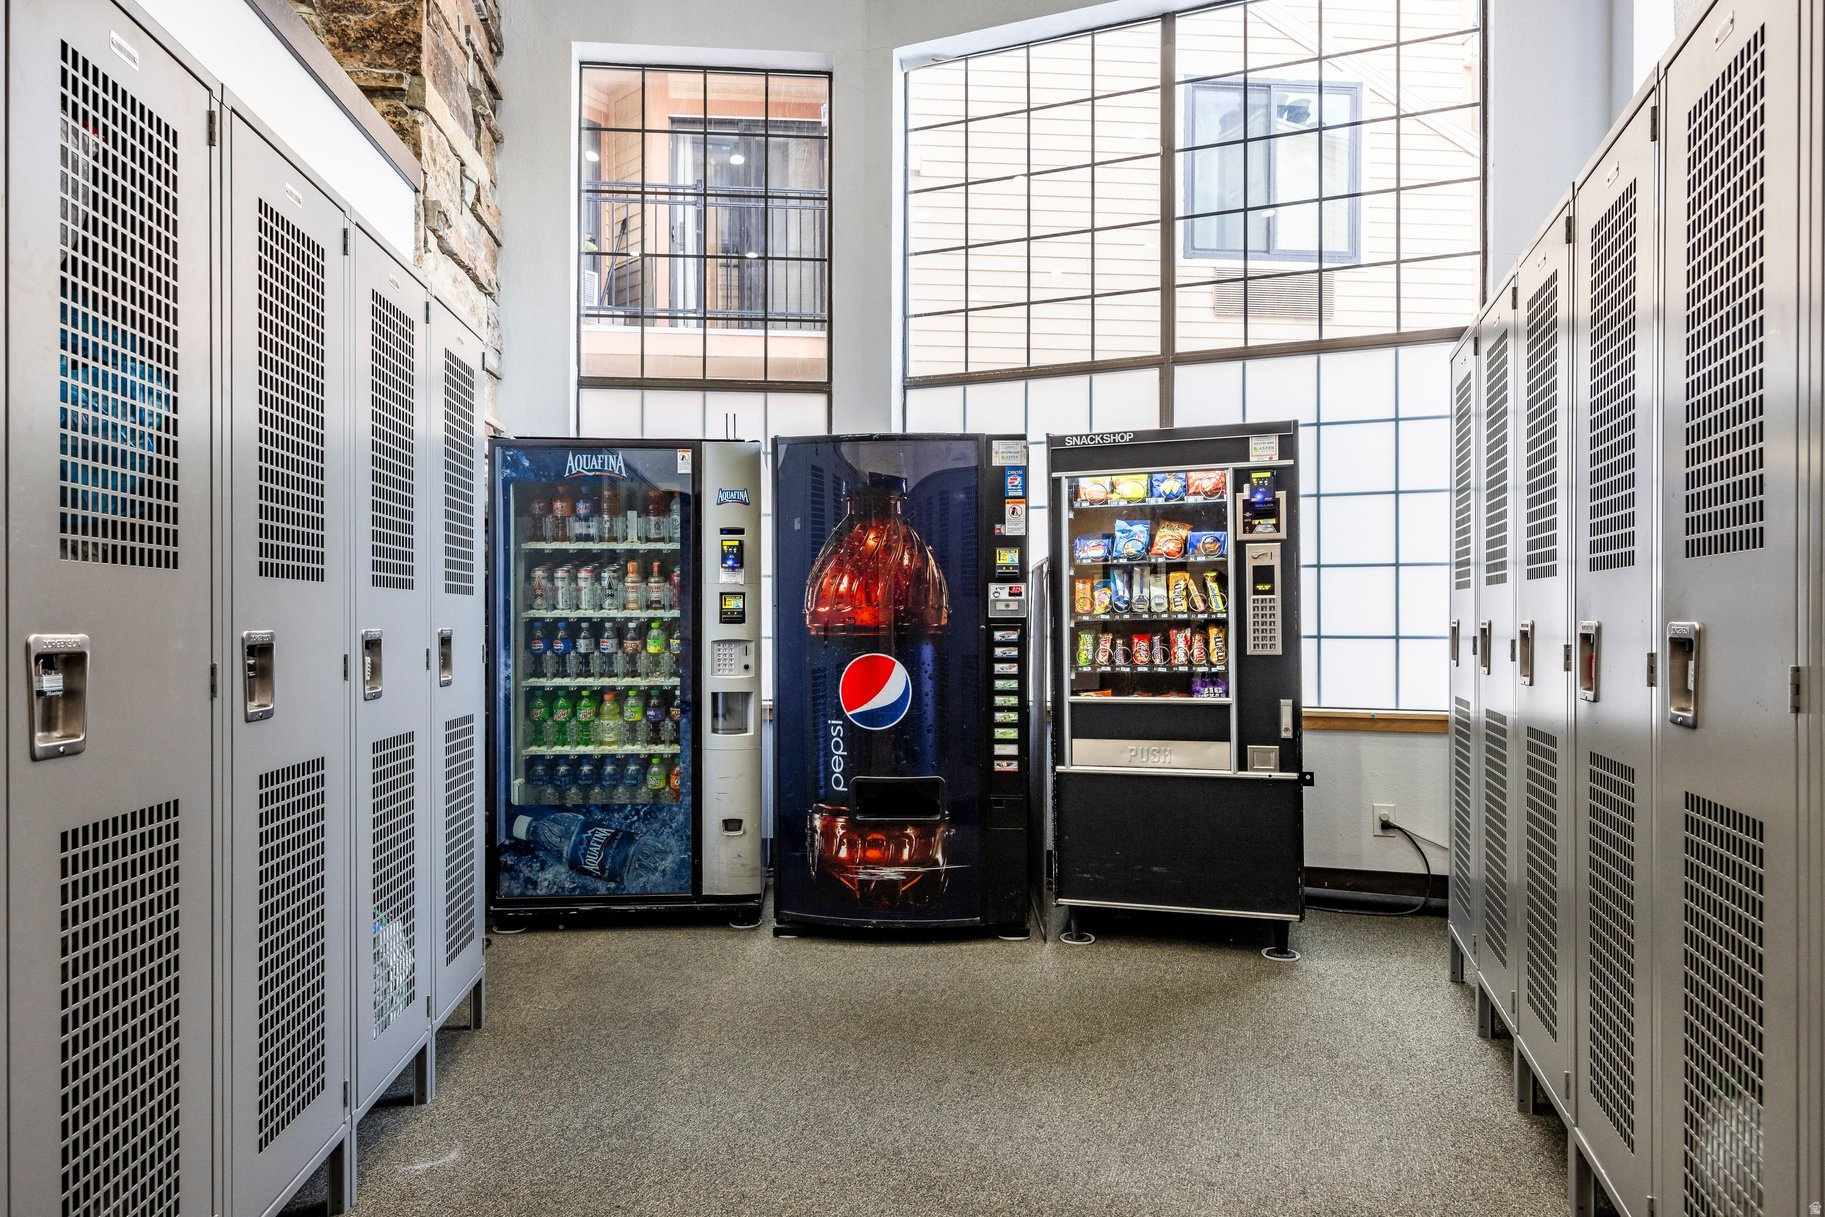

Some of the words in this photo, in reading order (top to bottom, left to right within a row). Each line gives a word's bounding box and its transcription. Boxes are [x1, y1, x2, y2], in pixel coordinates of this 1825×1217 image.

[1065, 432, 1134, 446] SNACKSHOP
[564, 450, 628, 477] AQUAFINA
[717, 488, 749, 504] AQUAFINA
[828, 719, 848, 791] pepsi
[1127, 745, 1172, 764] PUSH
[582, 826, 615, 876] AQUAFINA
